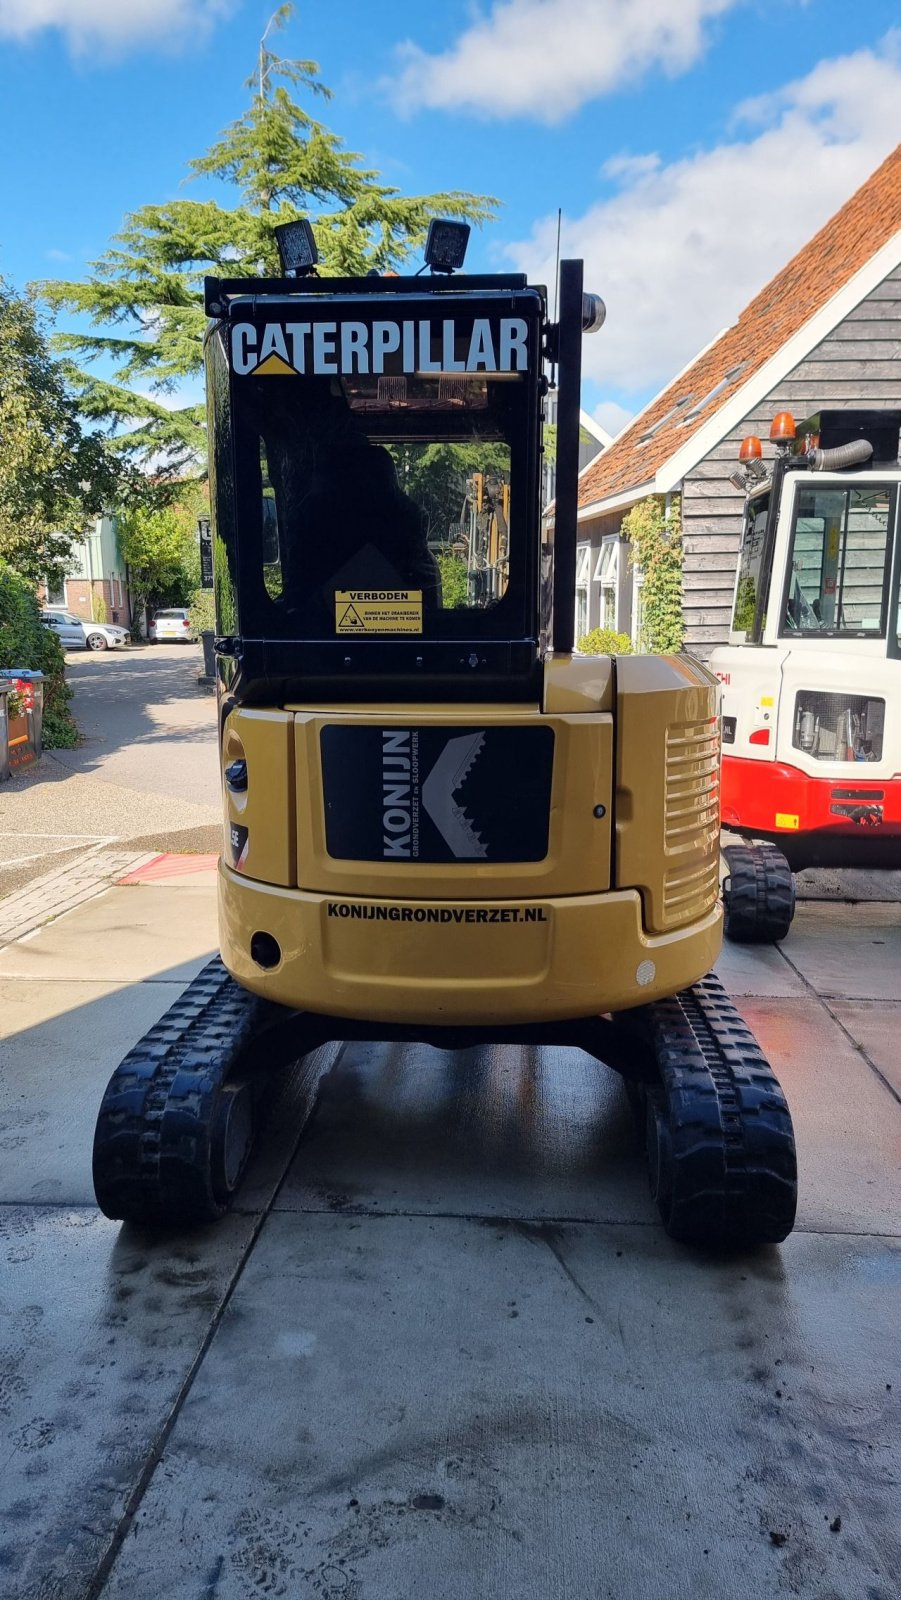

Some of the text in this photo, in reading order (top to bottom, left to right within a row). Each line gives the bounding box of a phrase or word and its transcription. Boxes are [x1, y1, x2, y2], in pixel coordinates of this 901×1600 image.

[231, 318, 529, 376] CATERPILLAR
[350, 592, 408, 600] VERBODEN
[382, 730, 411, 857] KONIJN
[328, 903, 547, 923] KONIJNGRONDVERZET.NL
